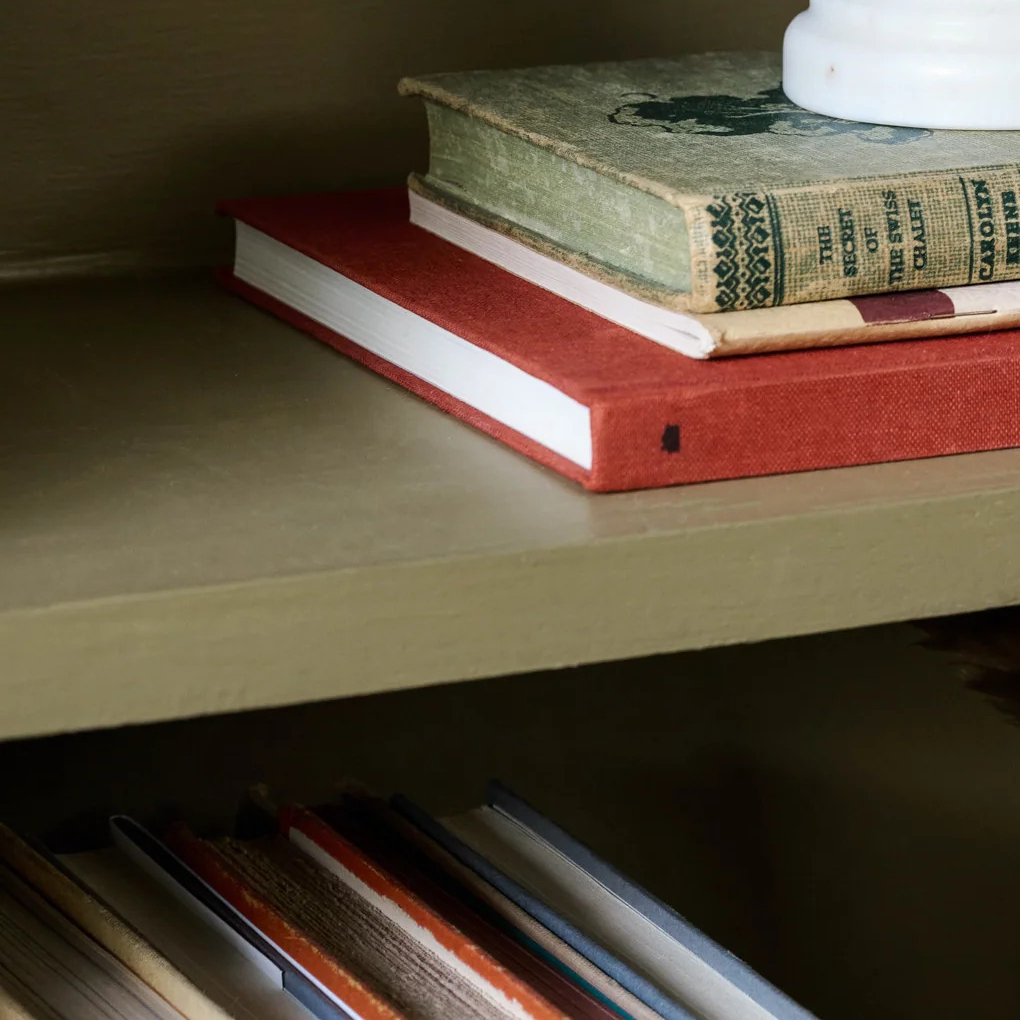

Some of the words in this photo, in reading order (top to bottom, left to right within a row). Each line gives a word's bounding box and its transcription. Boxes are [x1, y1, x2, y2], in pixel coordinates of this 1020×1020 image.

[817, 225, 832, 265] THE
[838, 207, 858, 277] SECRET
[864, 227, 878, 252] OF
[882, 189, 902, 243] SWISS
[907, 199, 927, 270] CHALET
[971, 179, 995, 280] CAROLYN
[1002, 191, 1020, 264] KEENE
[888, 248, 904, 284] THE
